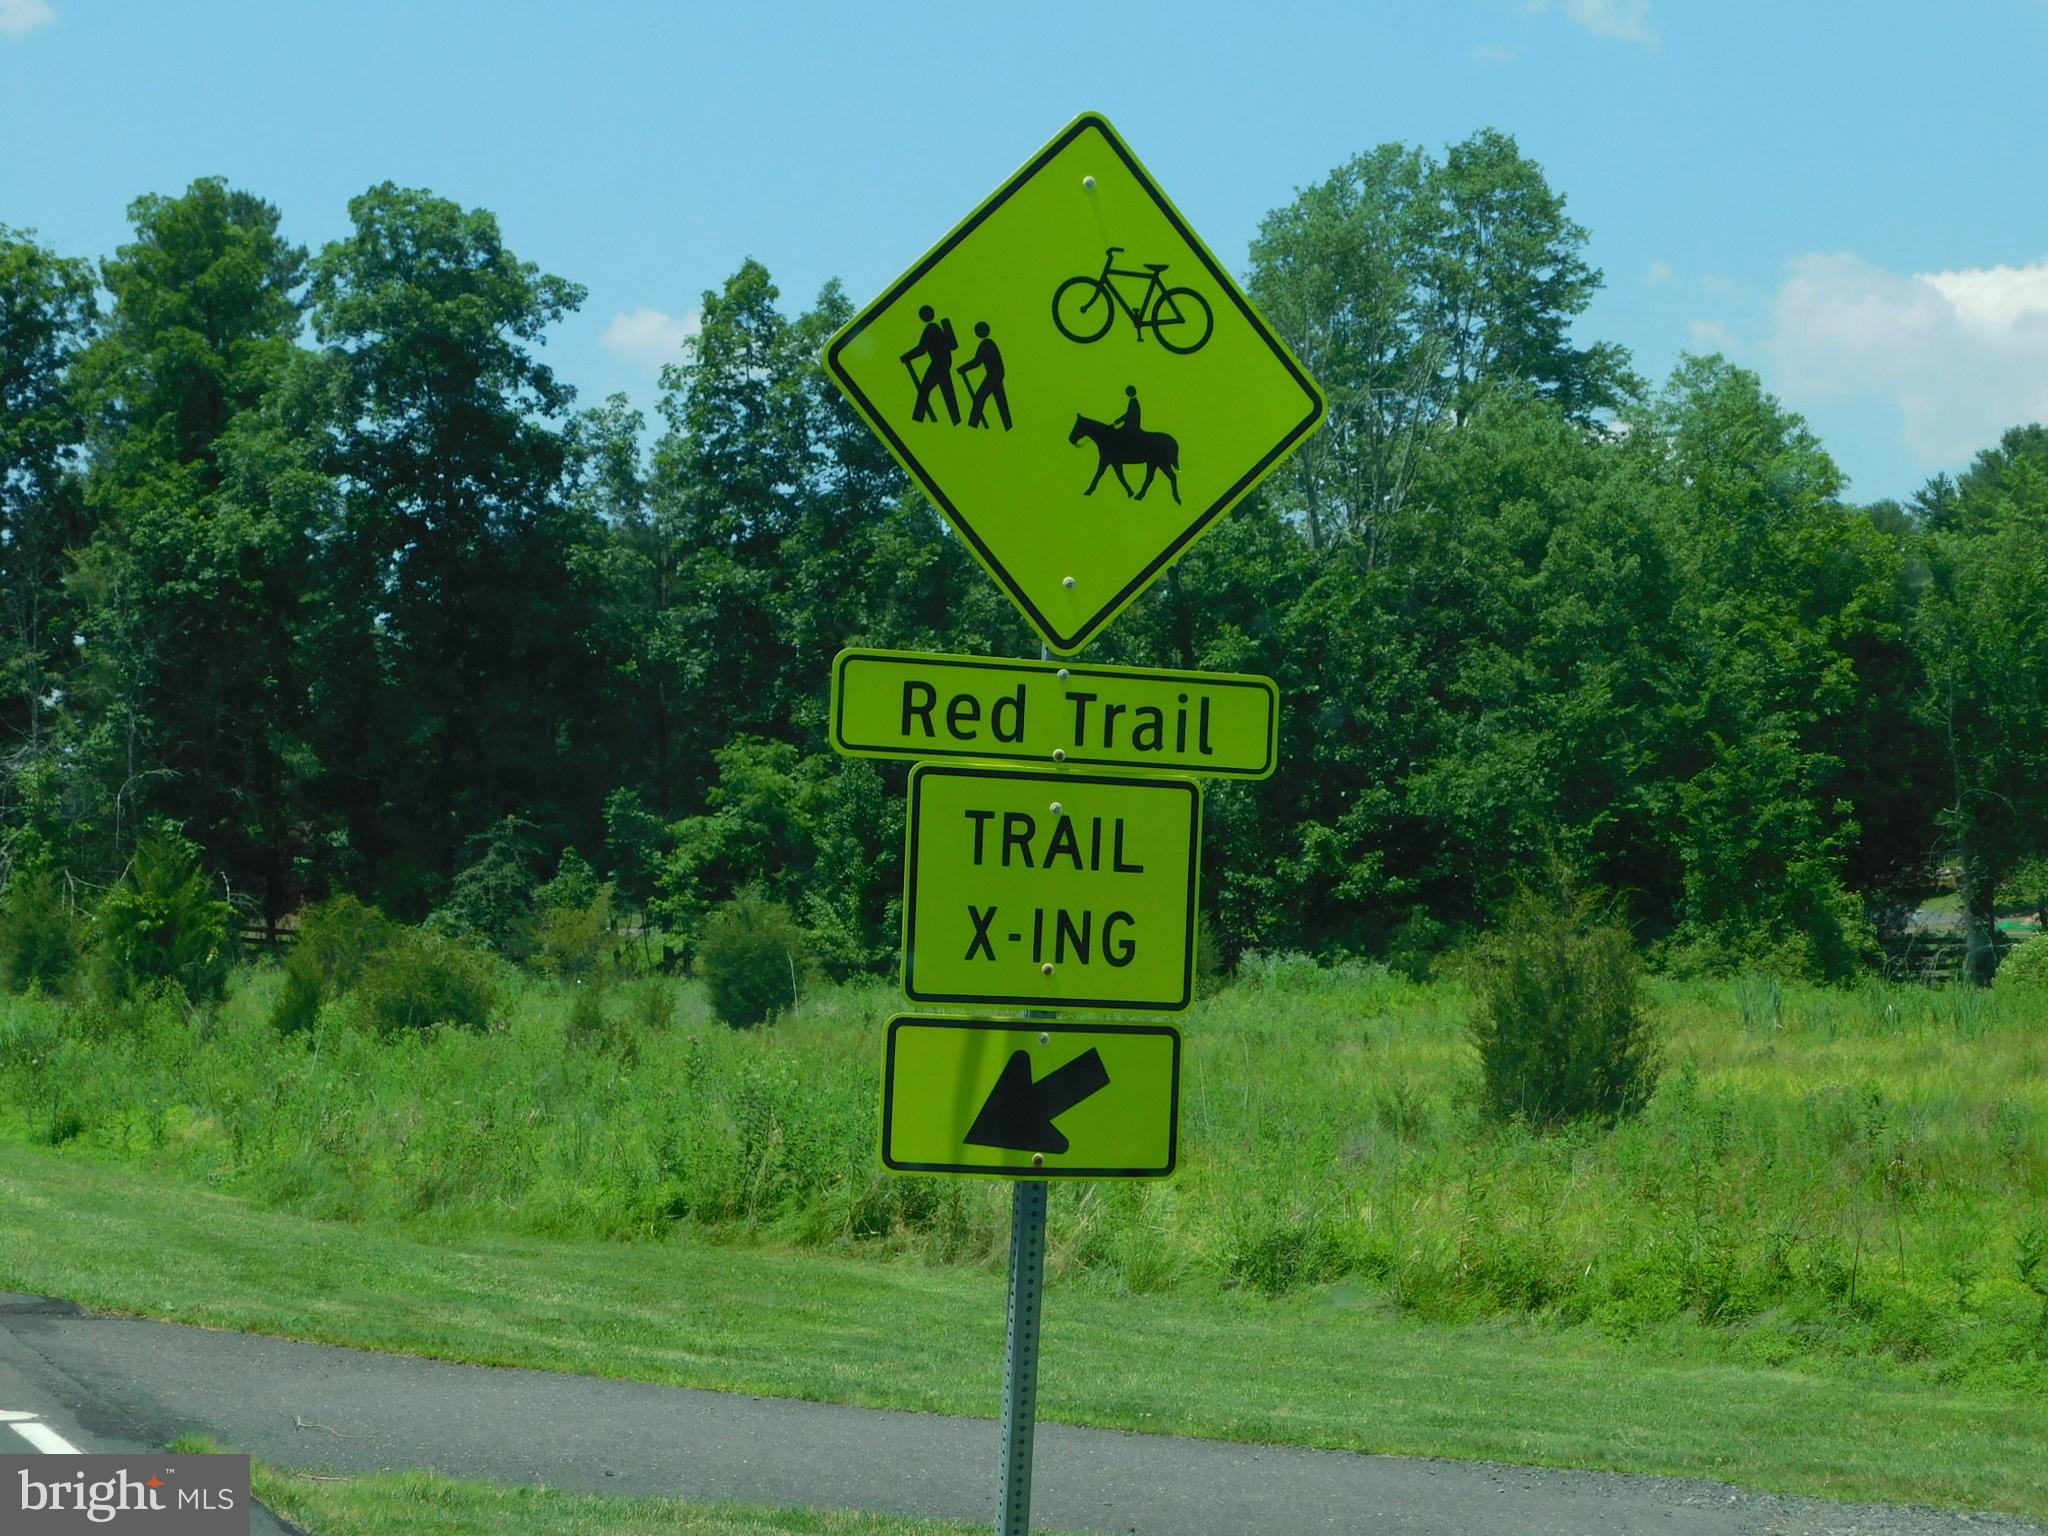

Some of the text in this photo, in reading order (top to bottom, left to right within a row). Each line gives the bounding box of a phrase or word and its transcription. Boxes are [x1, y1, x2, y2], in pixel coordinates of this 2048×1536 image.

[900, 680, 1214, 756] Red Trail
[963, 809, 1145, 874] TRAIL
[963, 904, 1137, 968] X-ING
